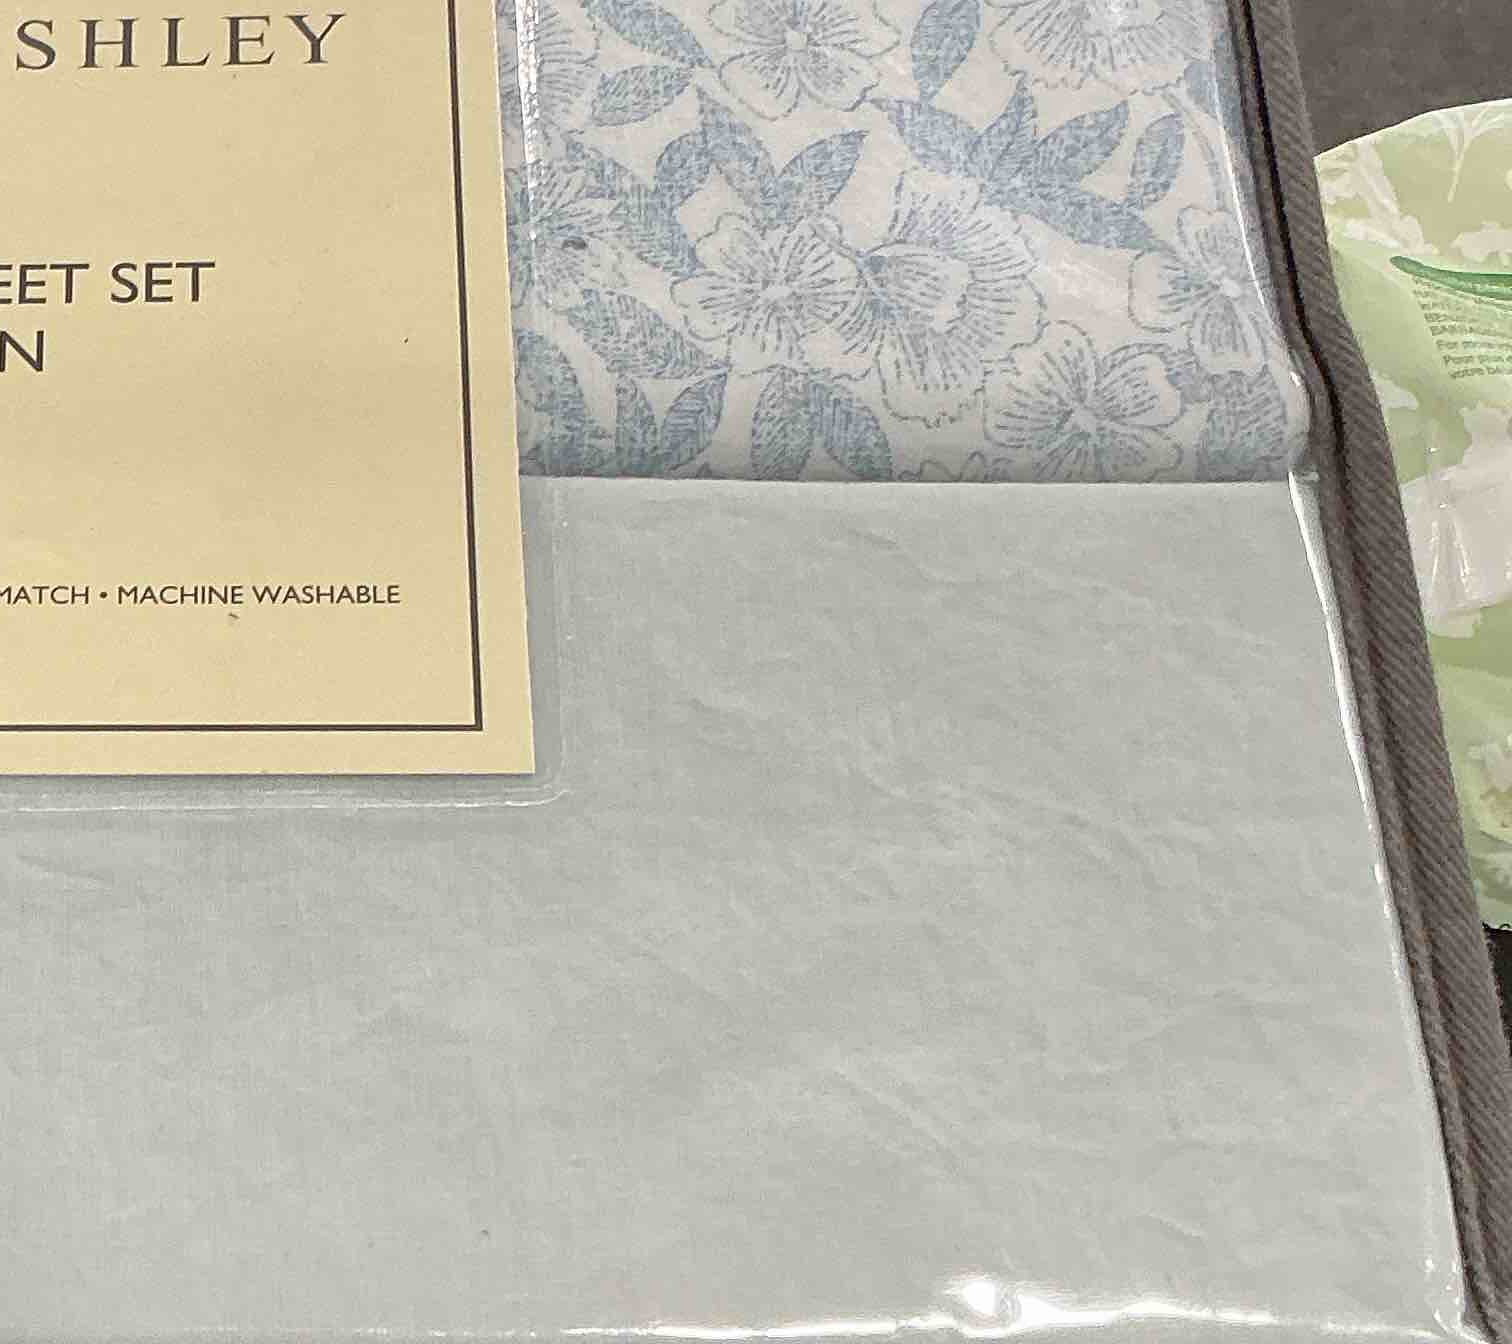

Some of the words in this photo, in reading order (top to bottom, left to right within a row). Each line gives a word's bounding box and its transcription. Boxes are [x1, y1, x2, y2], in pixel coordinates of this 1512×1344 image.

[110, 261, 216, 303] SET
[117, 584, 245, 605] MACHINE
[251, 584, 402, 605] WASHABLE
